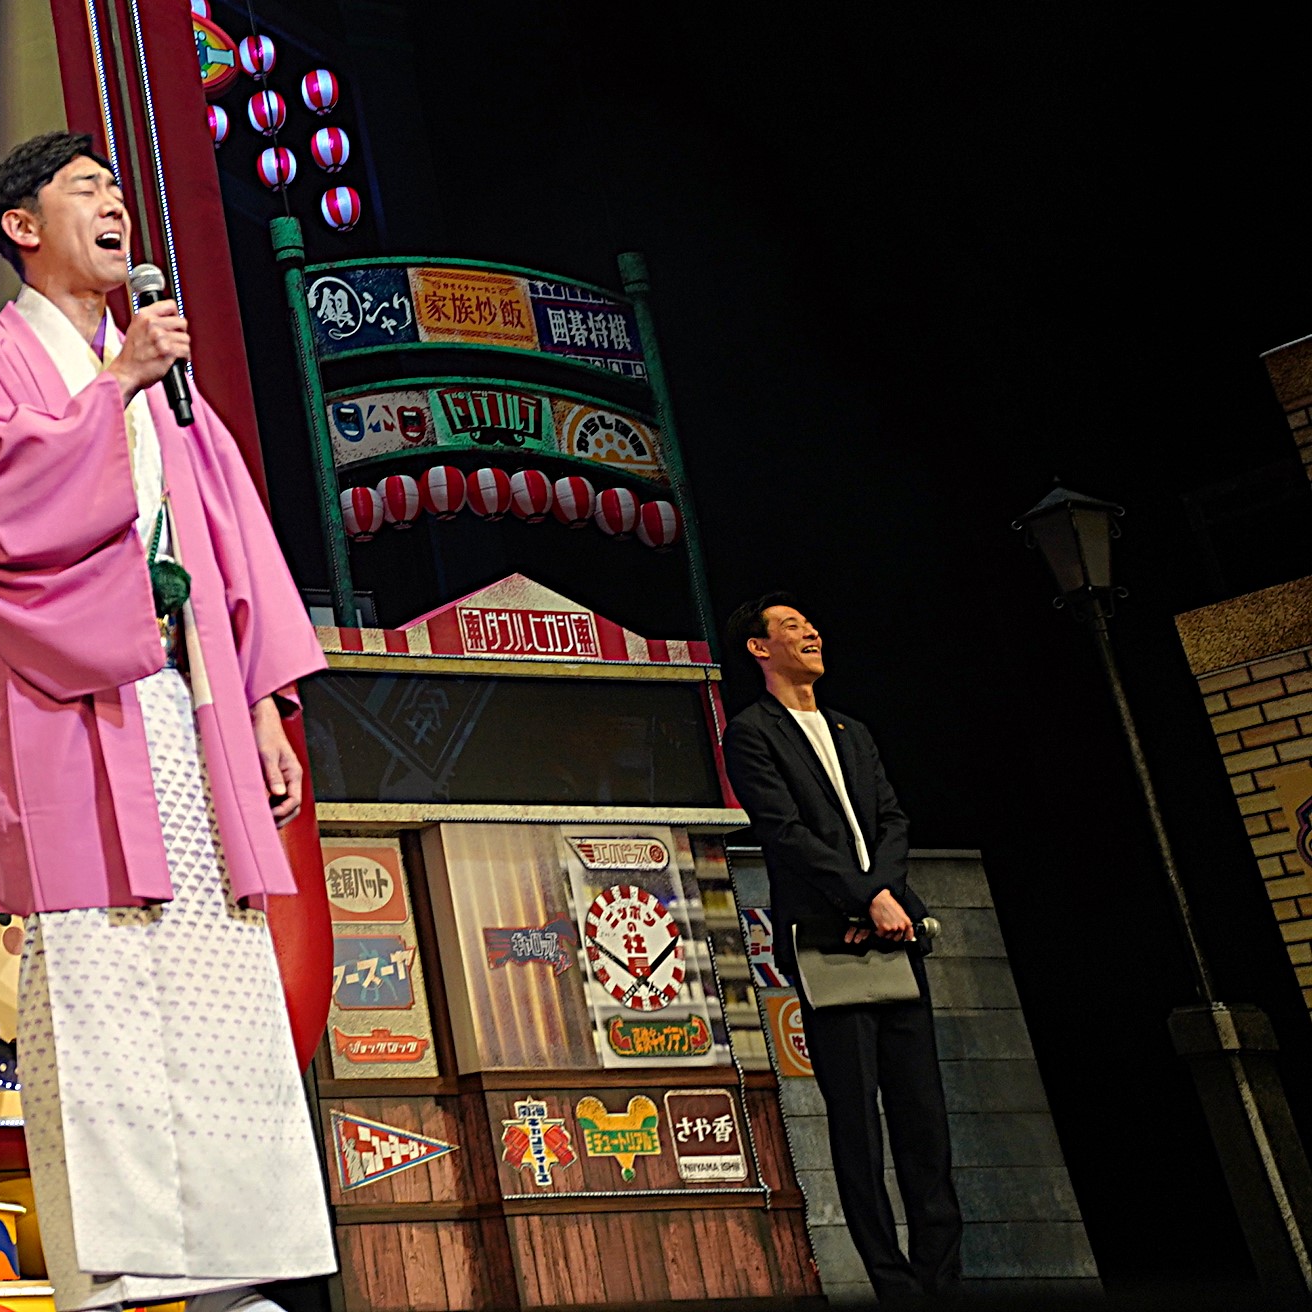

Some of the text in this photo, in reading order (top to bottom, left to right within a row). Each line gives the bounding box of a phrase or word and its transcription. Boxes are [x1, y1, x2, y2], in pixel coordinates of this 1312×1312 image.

[316, 287, 413, 336] 銀シャリ
[425, 290, 527, 329] 家族炒飯
[547, 306, 634, 352] 囲碁将棋
[593, 843, 652, 865] エバース
[327, 867, 389, 899] 金属バット
[675, 1114, 734, 1143] さや香
